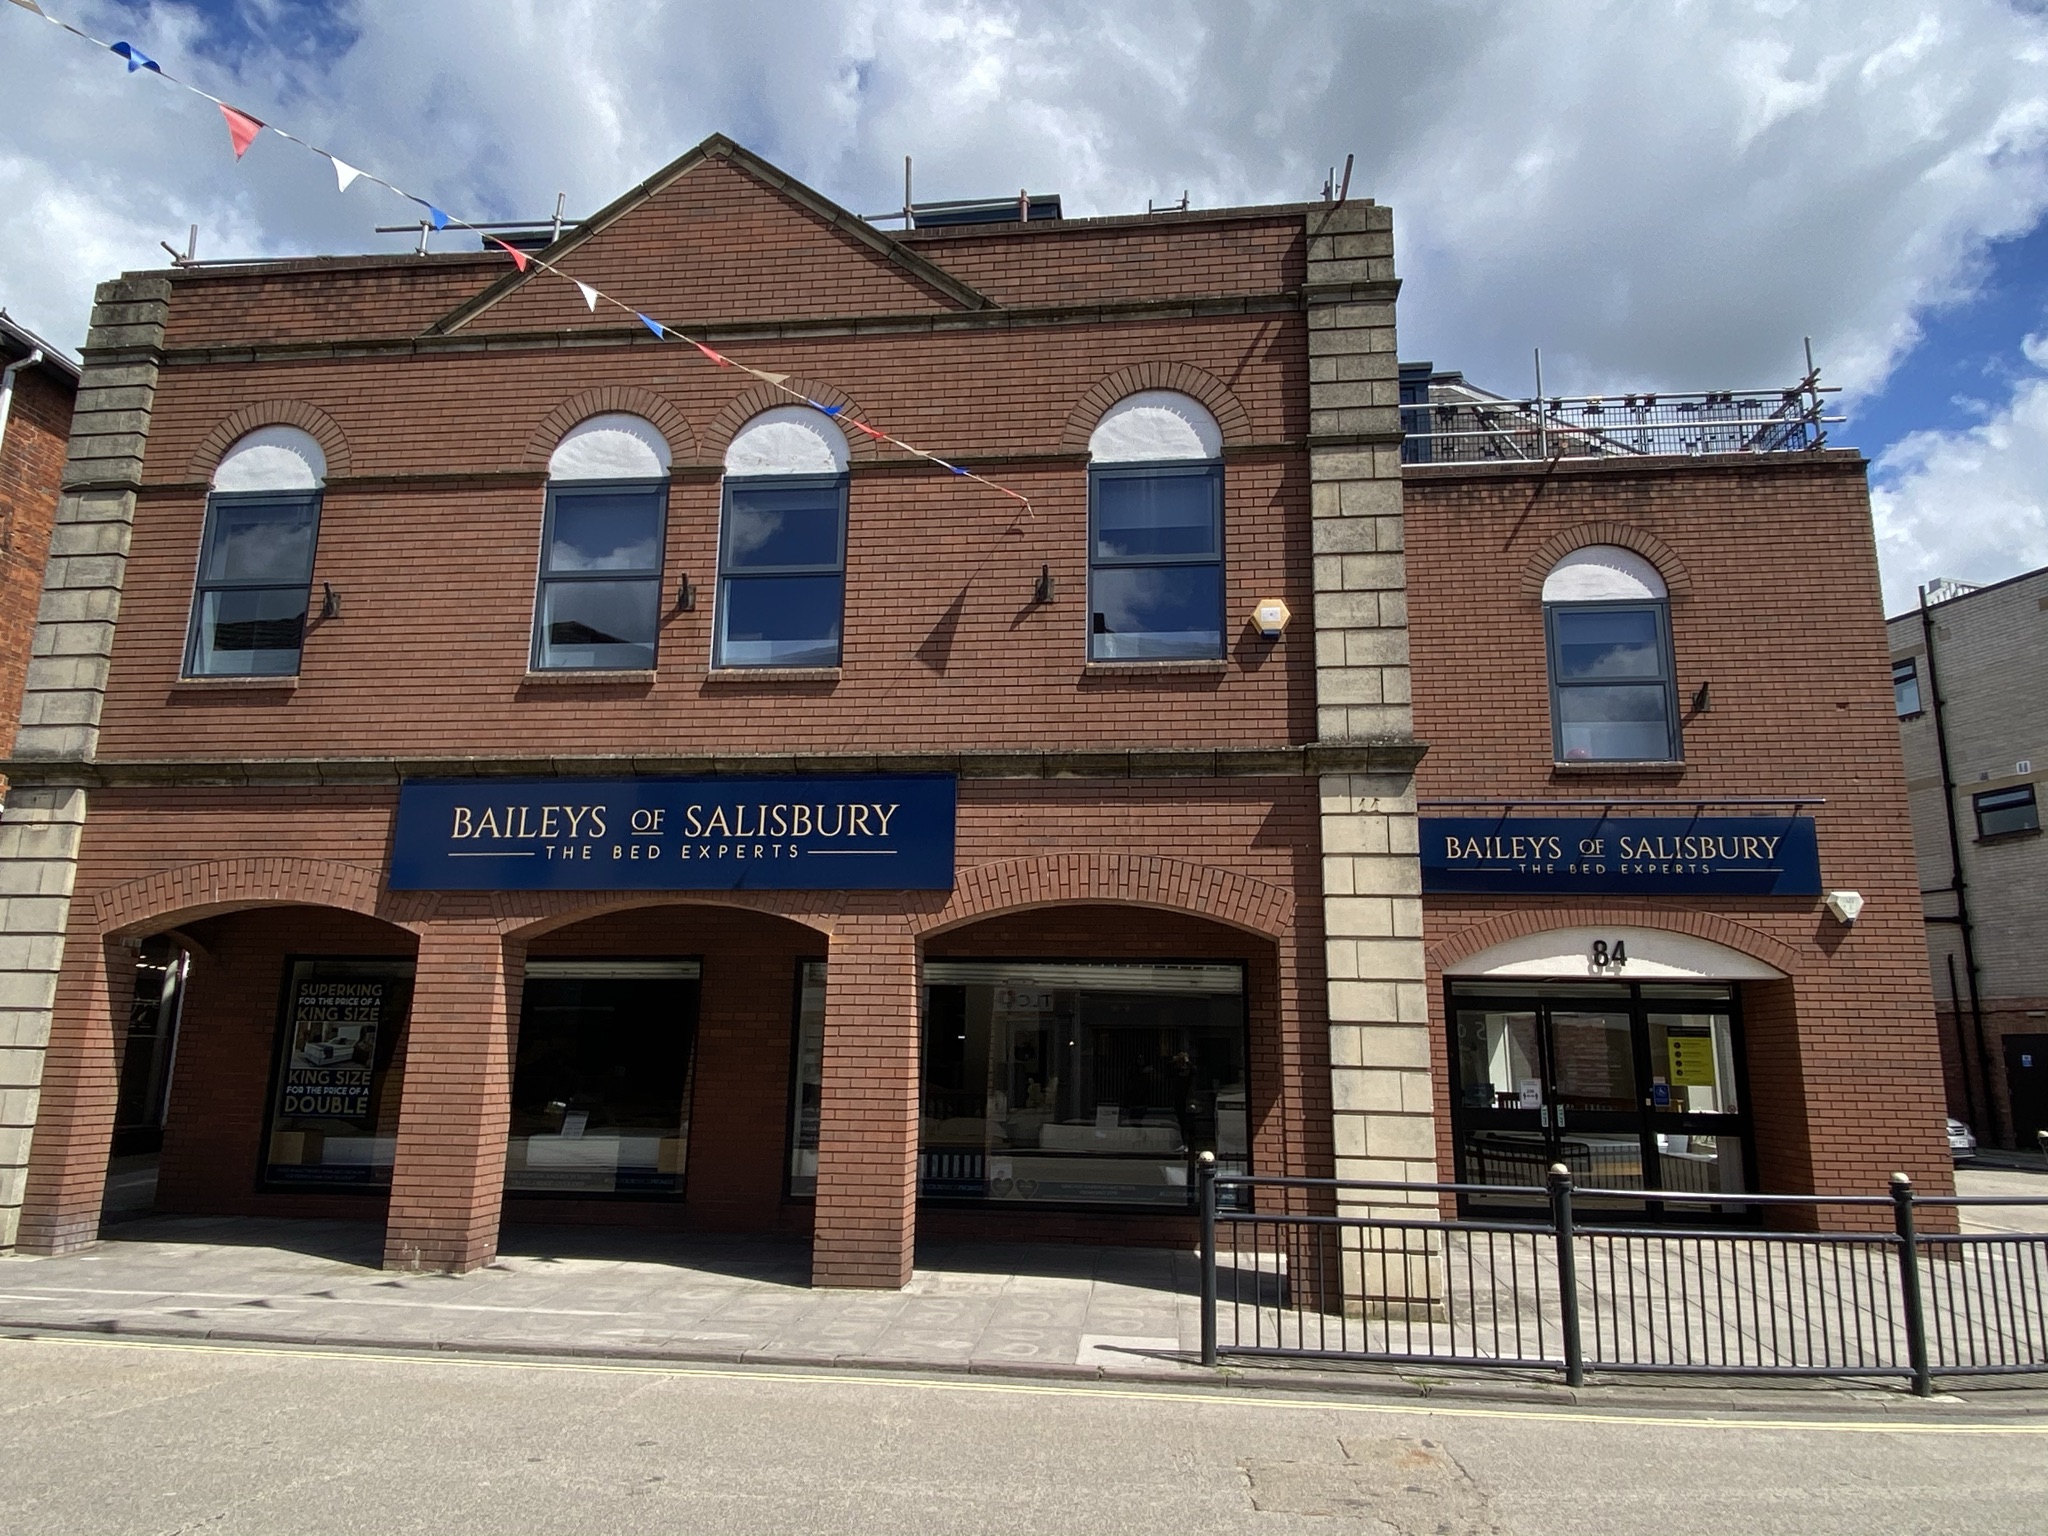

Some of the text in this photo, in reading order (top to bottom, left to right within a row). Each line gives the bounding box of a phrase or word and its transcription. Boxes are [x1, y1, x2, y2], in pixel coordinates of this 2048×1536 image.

[451, 803, 901, 839] BAILEYS OF SALISBURY
[545, 844, 800, 861] THE BED EXPERTS
[1445, 835, 1781, 861] BAILEYS OF SALISBURY
[1518, 863, 1711, 875] THE BED EXPERTS
[1592, 940, 1628, 967] 84
[300, 983, 383, 997] SUPERKING
[298, 997, 381, 1006] FOR THE PRICE OF A
[297, 1006, 380, 1021] KING SIZE
[288, 1070, 372, 1086] KING SIZE
[286, 1086, 369, 1096] FOR THE PRICE OF A
[284, 1096, 369, 1114] DOUBLE
